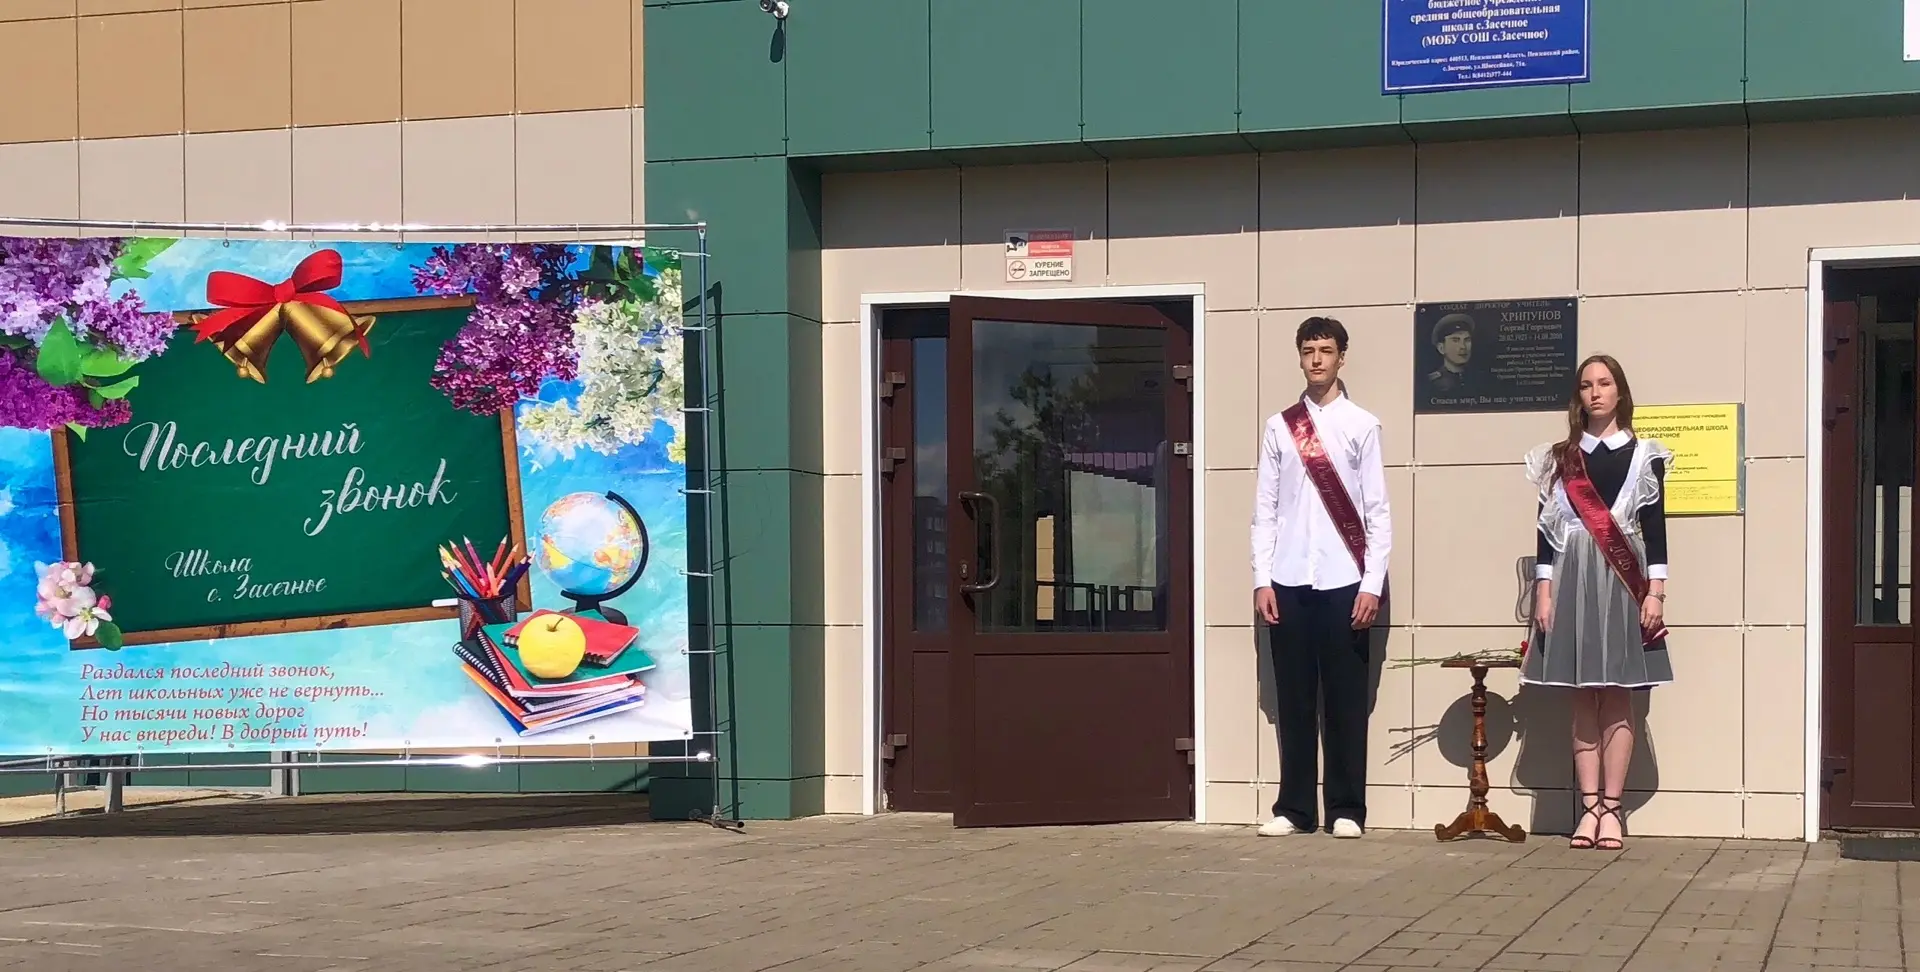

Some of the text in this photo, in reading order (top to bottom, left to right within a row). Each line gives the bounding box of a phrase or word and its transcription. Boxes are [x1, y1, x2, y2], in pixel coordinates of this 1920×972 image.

[1410, 4, 1560, 24] средняя общеобразовательная
[1441, 19, 1528, 32] школа с.Засечное
[1421, 29, 1548, 48] (МОБУ СОШ с.Засечное)
[1500, 310, 1562, 322] ХРИПУНОВ
[1634, 425, 1704, 433] ЩЕОБРАЗОВАТЕЛЬНАЯ
[123, 421, 366, 486] Последний
[303, 458, 458, 536] звонок
[164, 548, 254, 578] Школа
[206, 573, 327, 603] с. Засечное
[79, 661, 336, 681] Раздался последний звонок,
[79, 685, 123, 701] Лет
[128, 686, 225, 701] школьных
[227, 687, 264, 704] уже
[269, 686, 289, 699] не
[80, 702, 305, 726] Но тысячи новых дорог
[80, 721, 369, 748] У нас впереди! В добрый путь!
